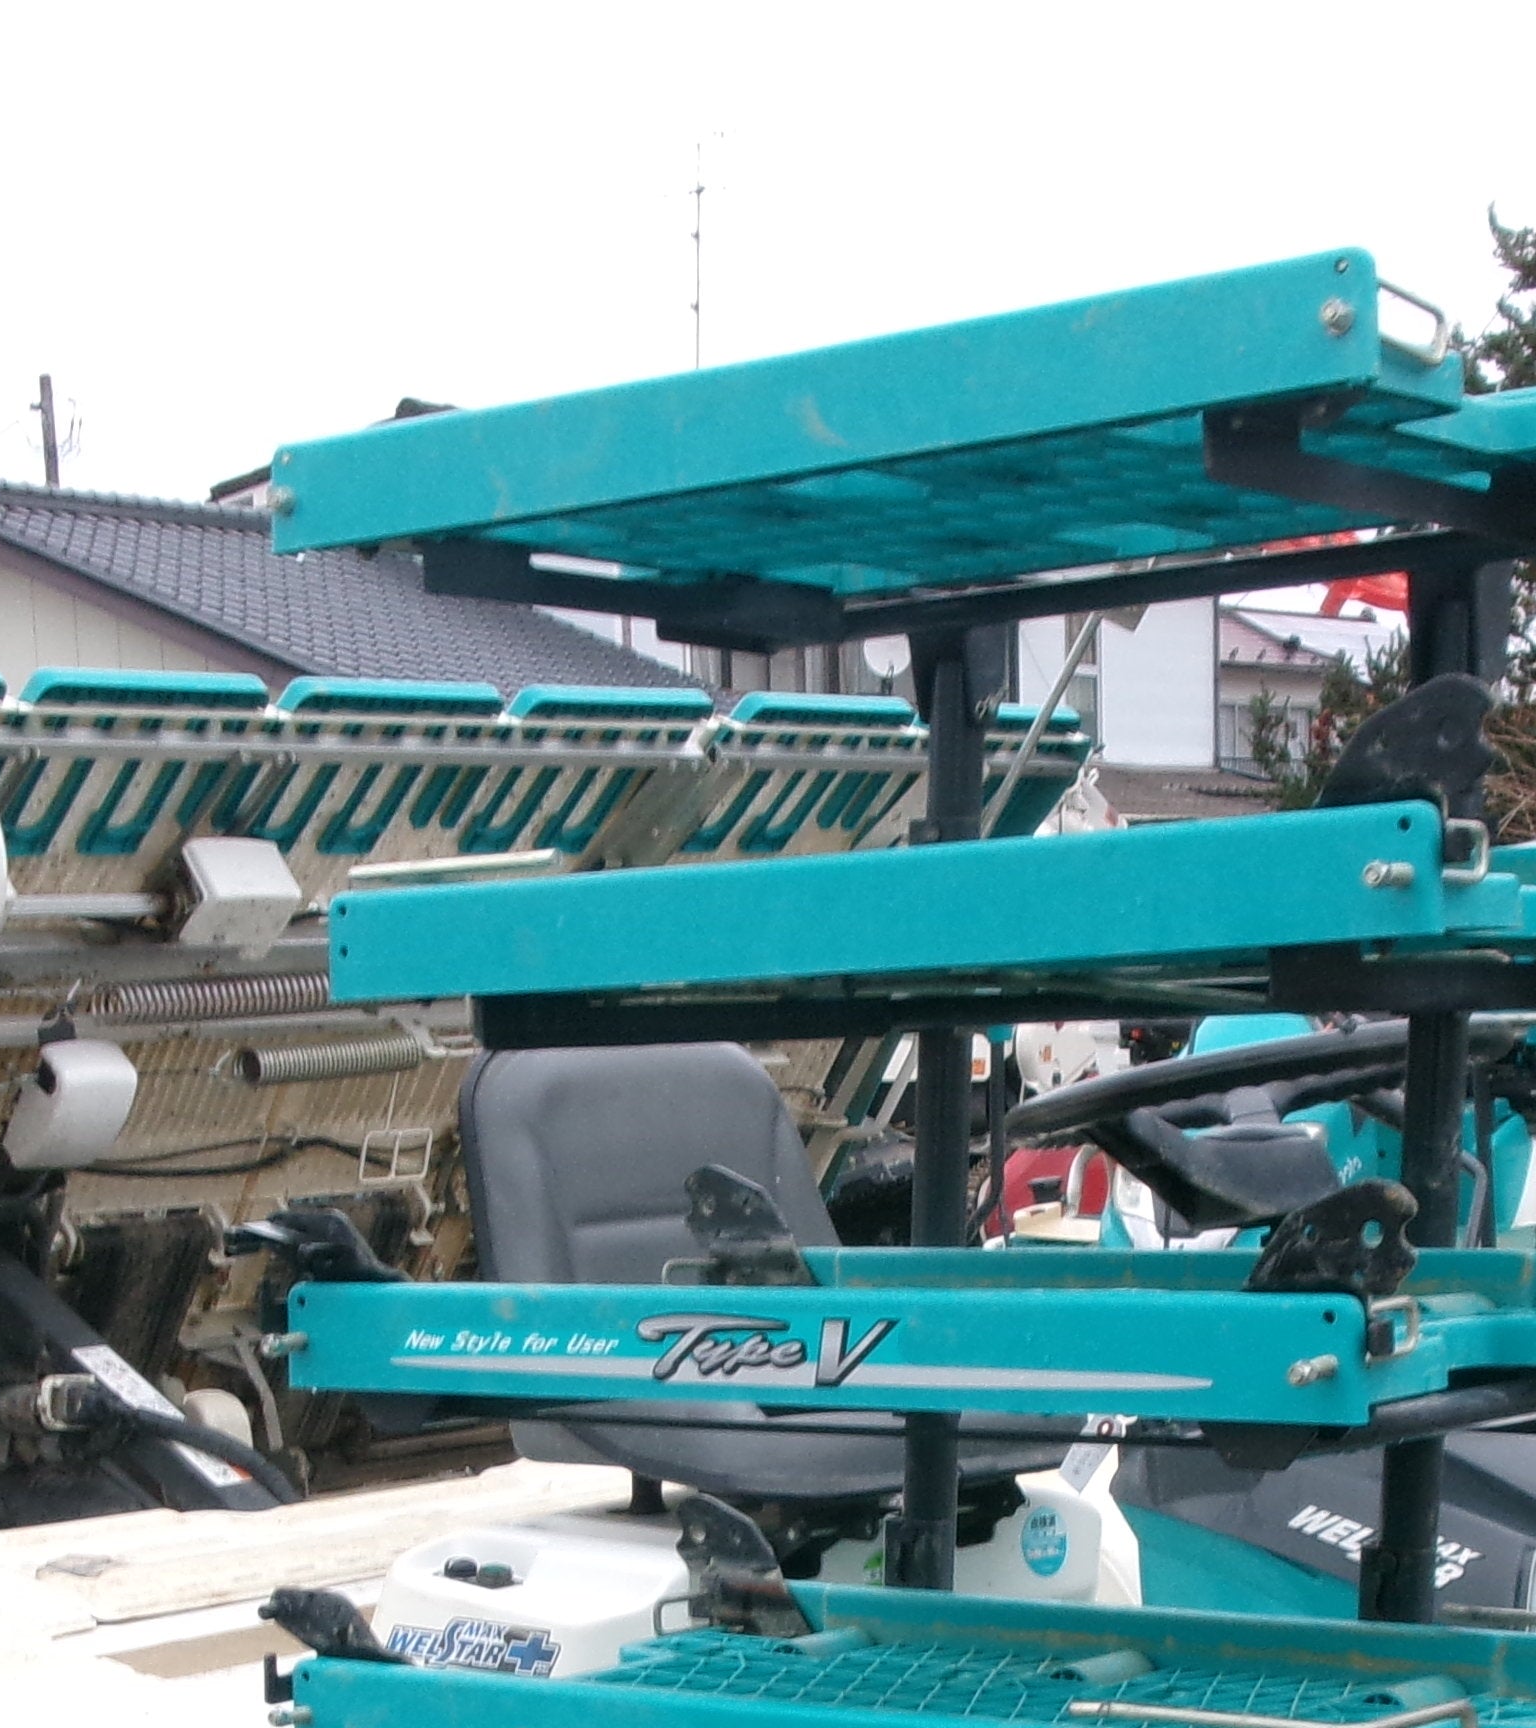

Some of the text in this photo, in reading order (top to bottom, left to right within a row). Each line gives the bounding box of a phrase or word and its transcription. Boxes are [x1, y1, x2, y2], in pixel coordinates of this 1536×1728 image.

[405, 1330, 619, 1355] New Style for User
[636, 1311, 901, 1388] Type V
[388, 1617, 507, 1667] WELSTAR
[463, 1620, 509, 1641] MAX
